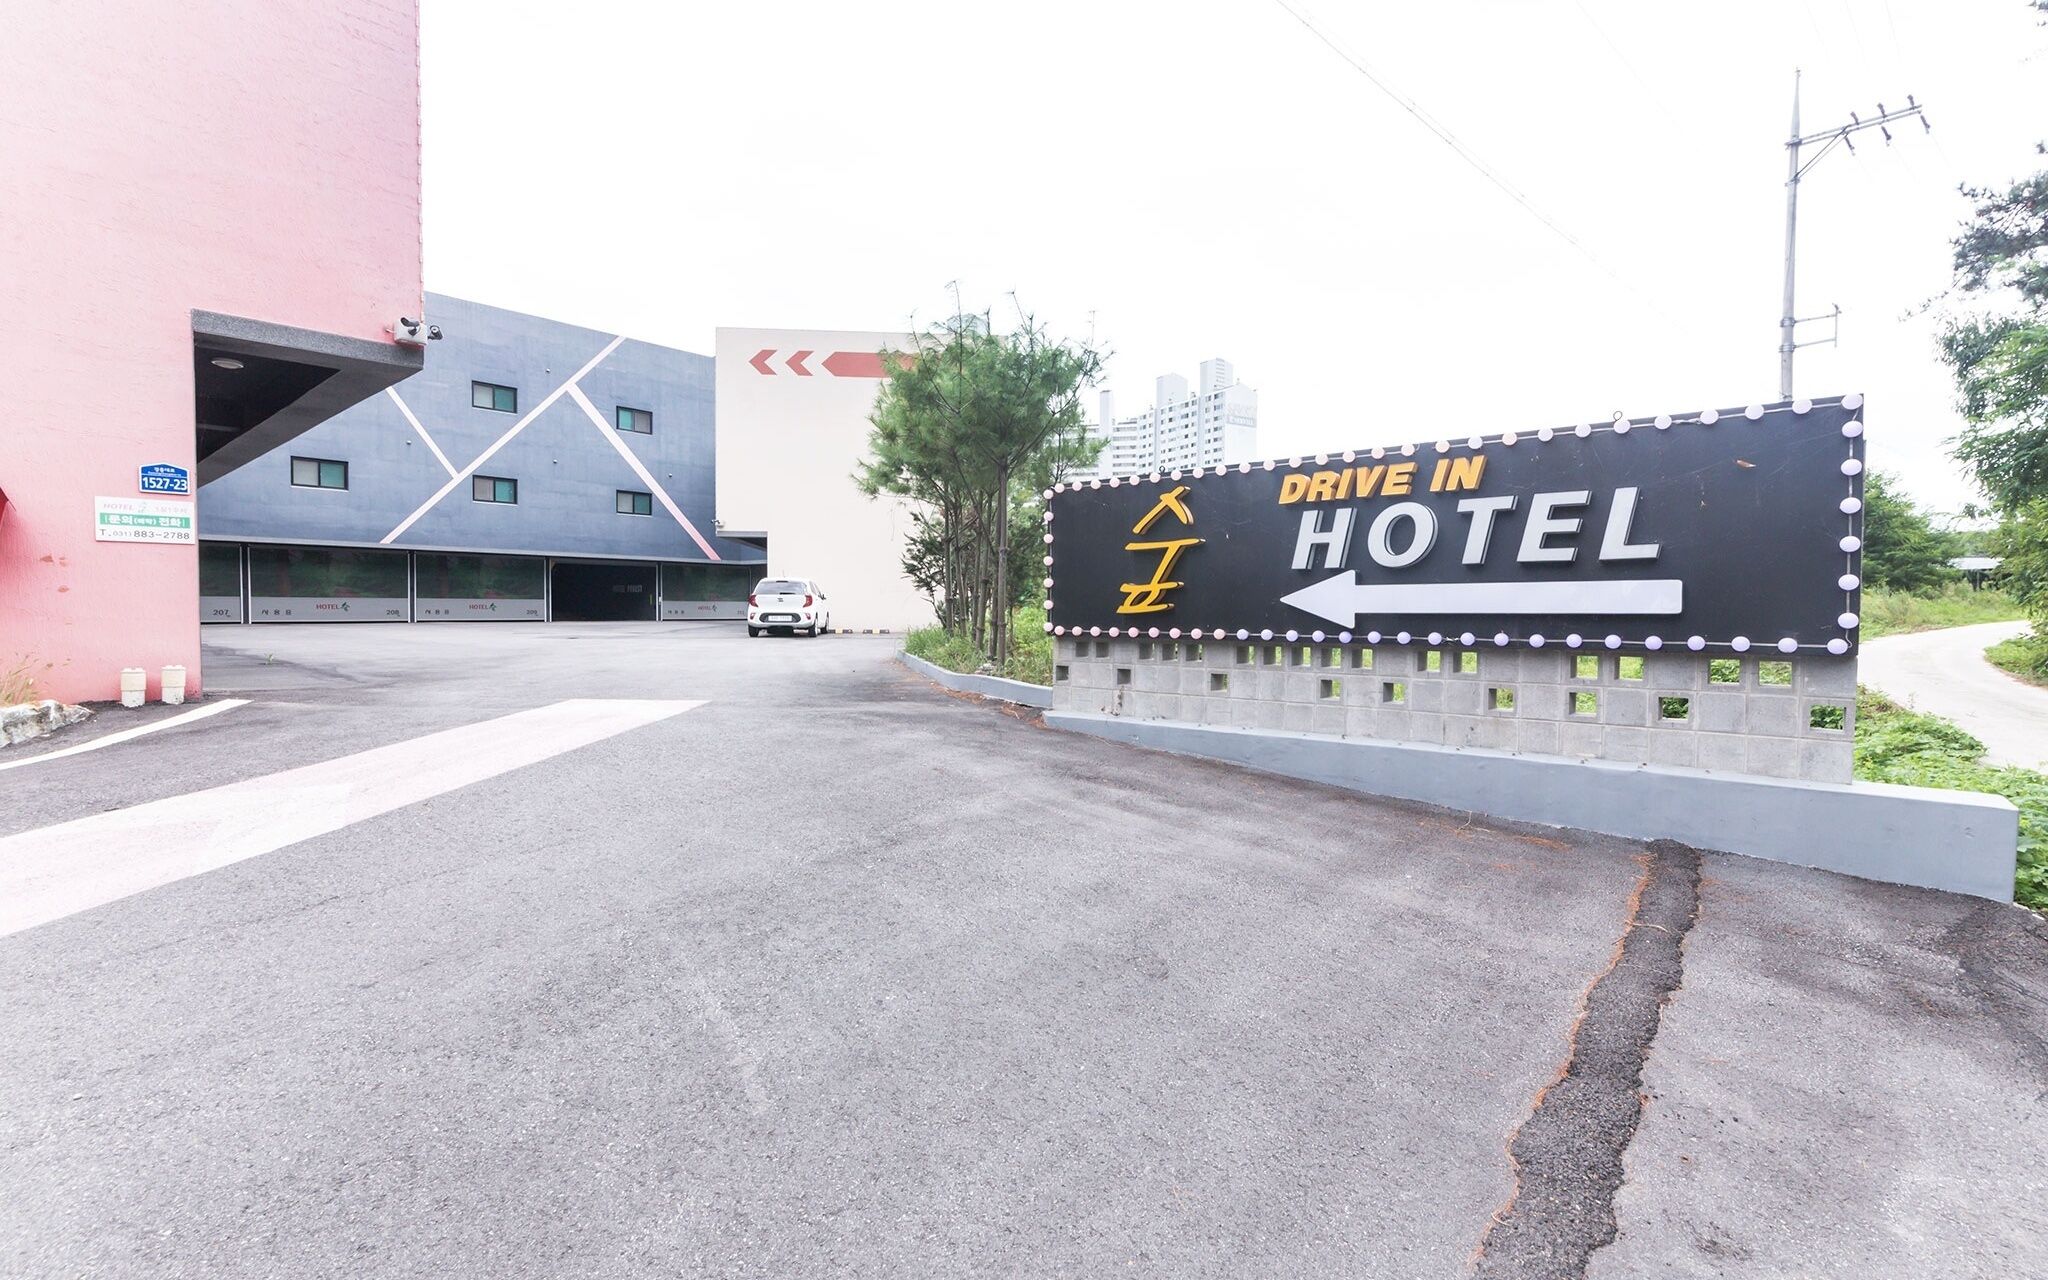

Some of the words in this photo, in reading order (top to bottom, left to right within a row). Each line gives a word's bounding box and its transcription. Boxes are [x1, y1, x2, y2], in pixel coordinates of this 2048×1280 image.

[142, 476, 187, 491] 1527-23
[1278, 462, 1418, 506] DRIVE
[1430, 454, 1488, 493] IN
[103, 503, 133, 511] HOTEL
[1290, 486, 1661, 571] HOTEL
